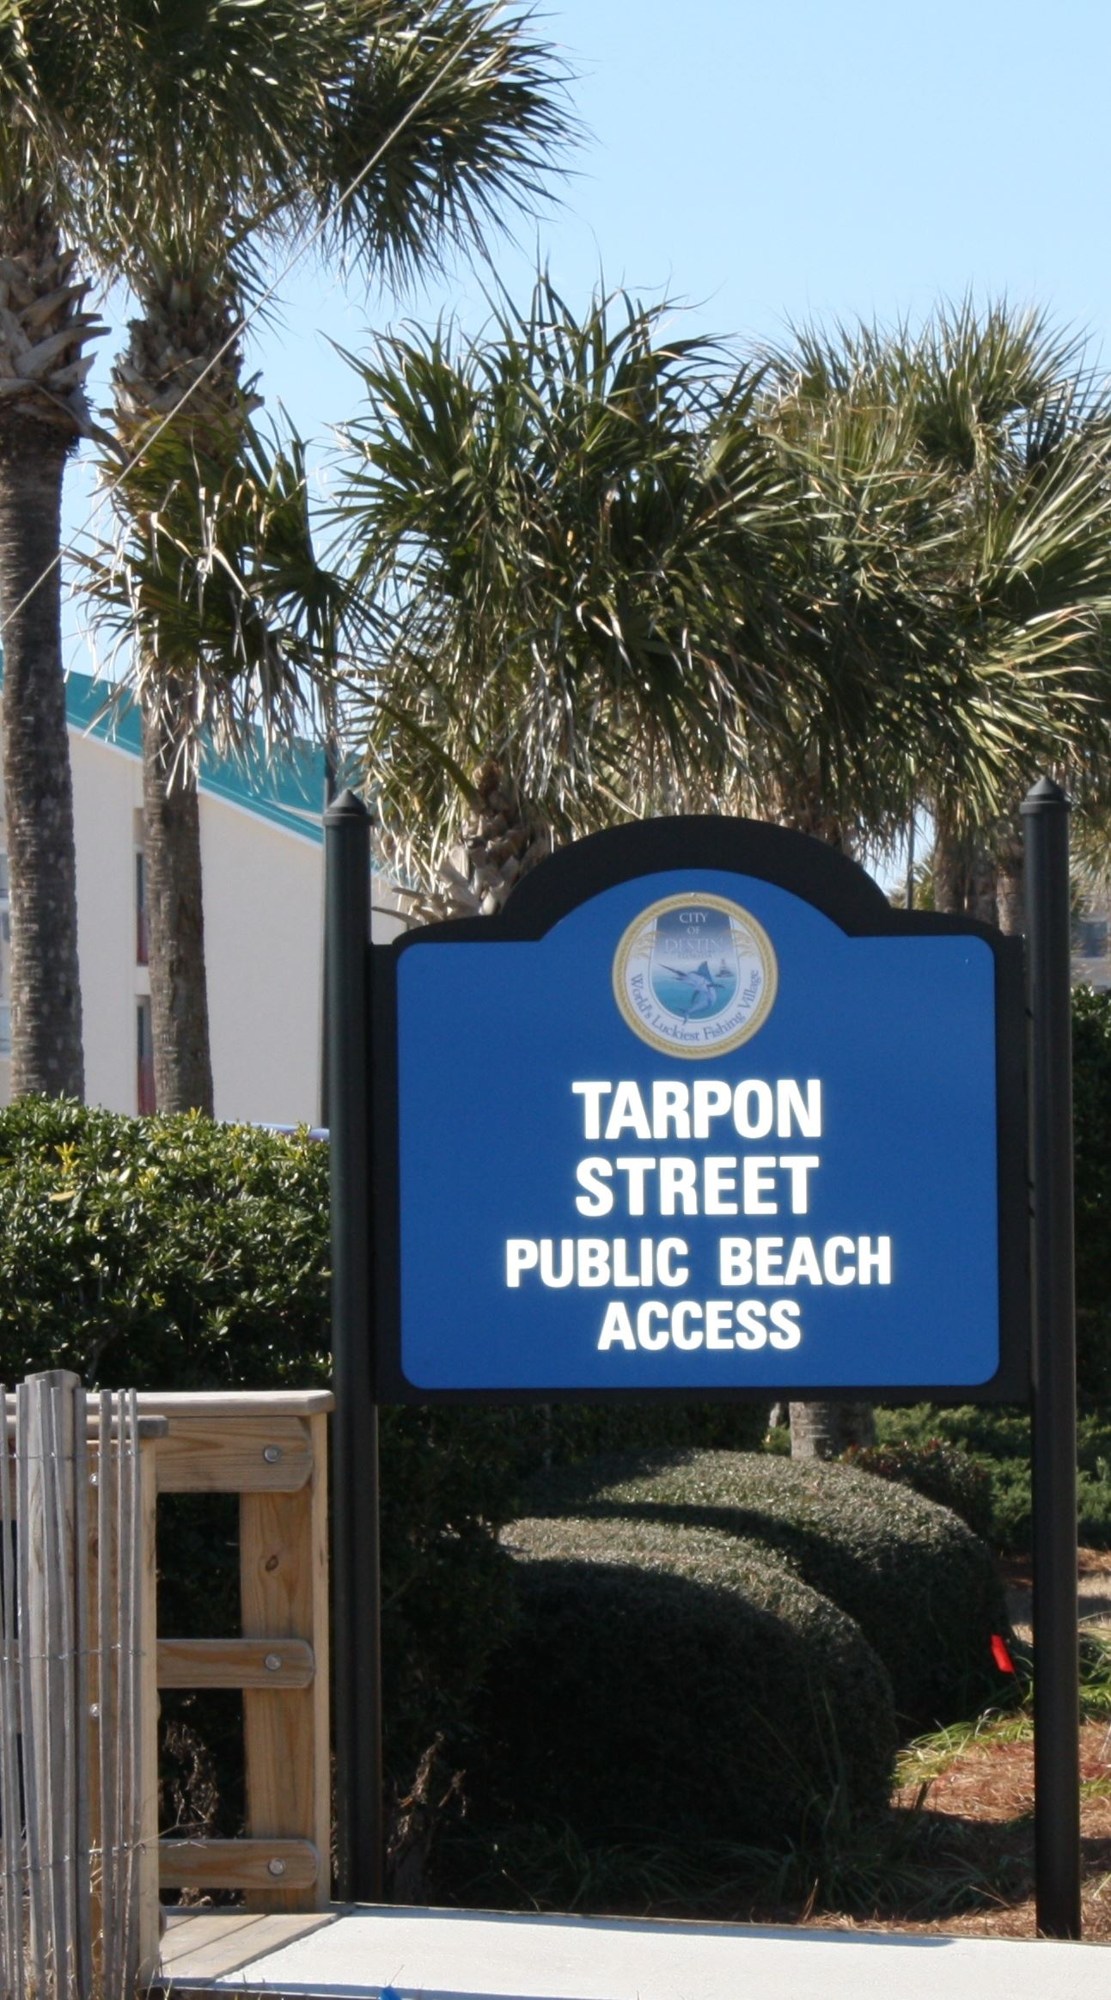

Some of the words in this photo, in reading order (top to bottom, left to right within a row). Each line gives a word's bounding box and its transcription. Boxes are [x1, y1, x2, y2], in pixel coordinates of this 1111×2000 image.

[679, 911, 709, 924] CITY
[687, 926, 701, 935] OF
[664, 937, 723, 951] DESTIN
[631, 973, 653, 1020] World's
[652, 1015, 700, 1041] Luckiest
[703, 1012, 746, 1040] Fishing
[738, 969, 761, 1009] Village
[572, 1079, 822, 1140] TARPON
[575, 1156, 820, 1217] STREET
[506, 1238, 690, 1288] PUBLIC
[719, 1236, 892, 1287] BEACH
[597, 1300, 802, 1351] ACCESS
